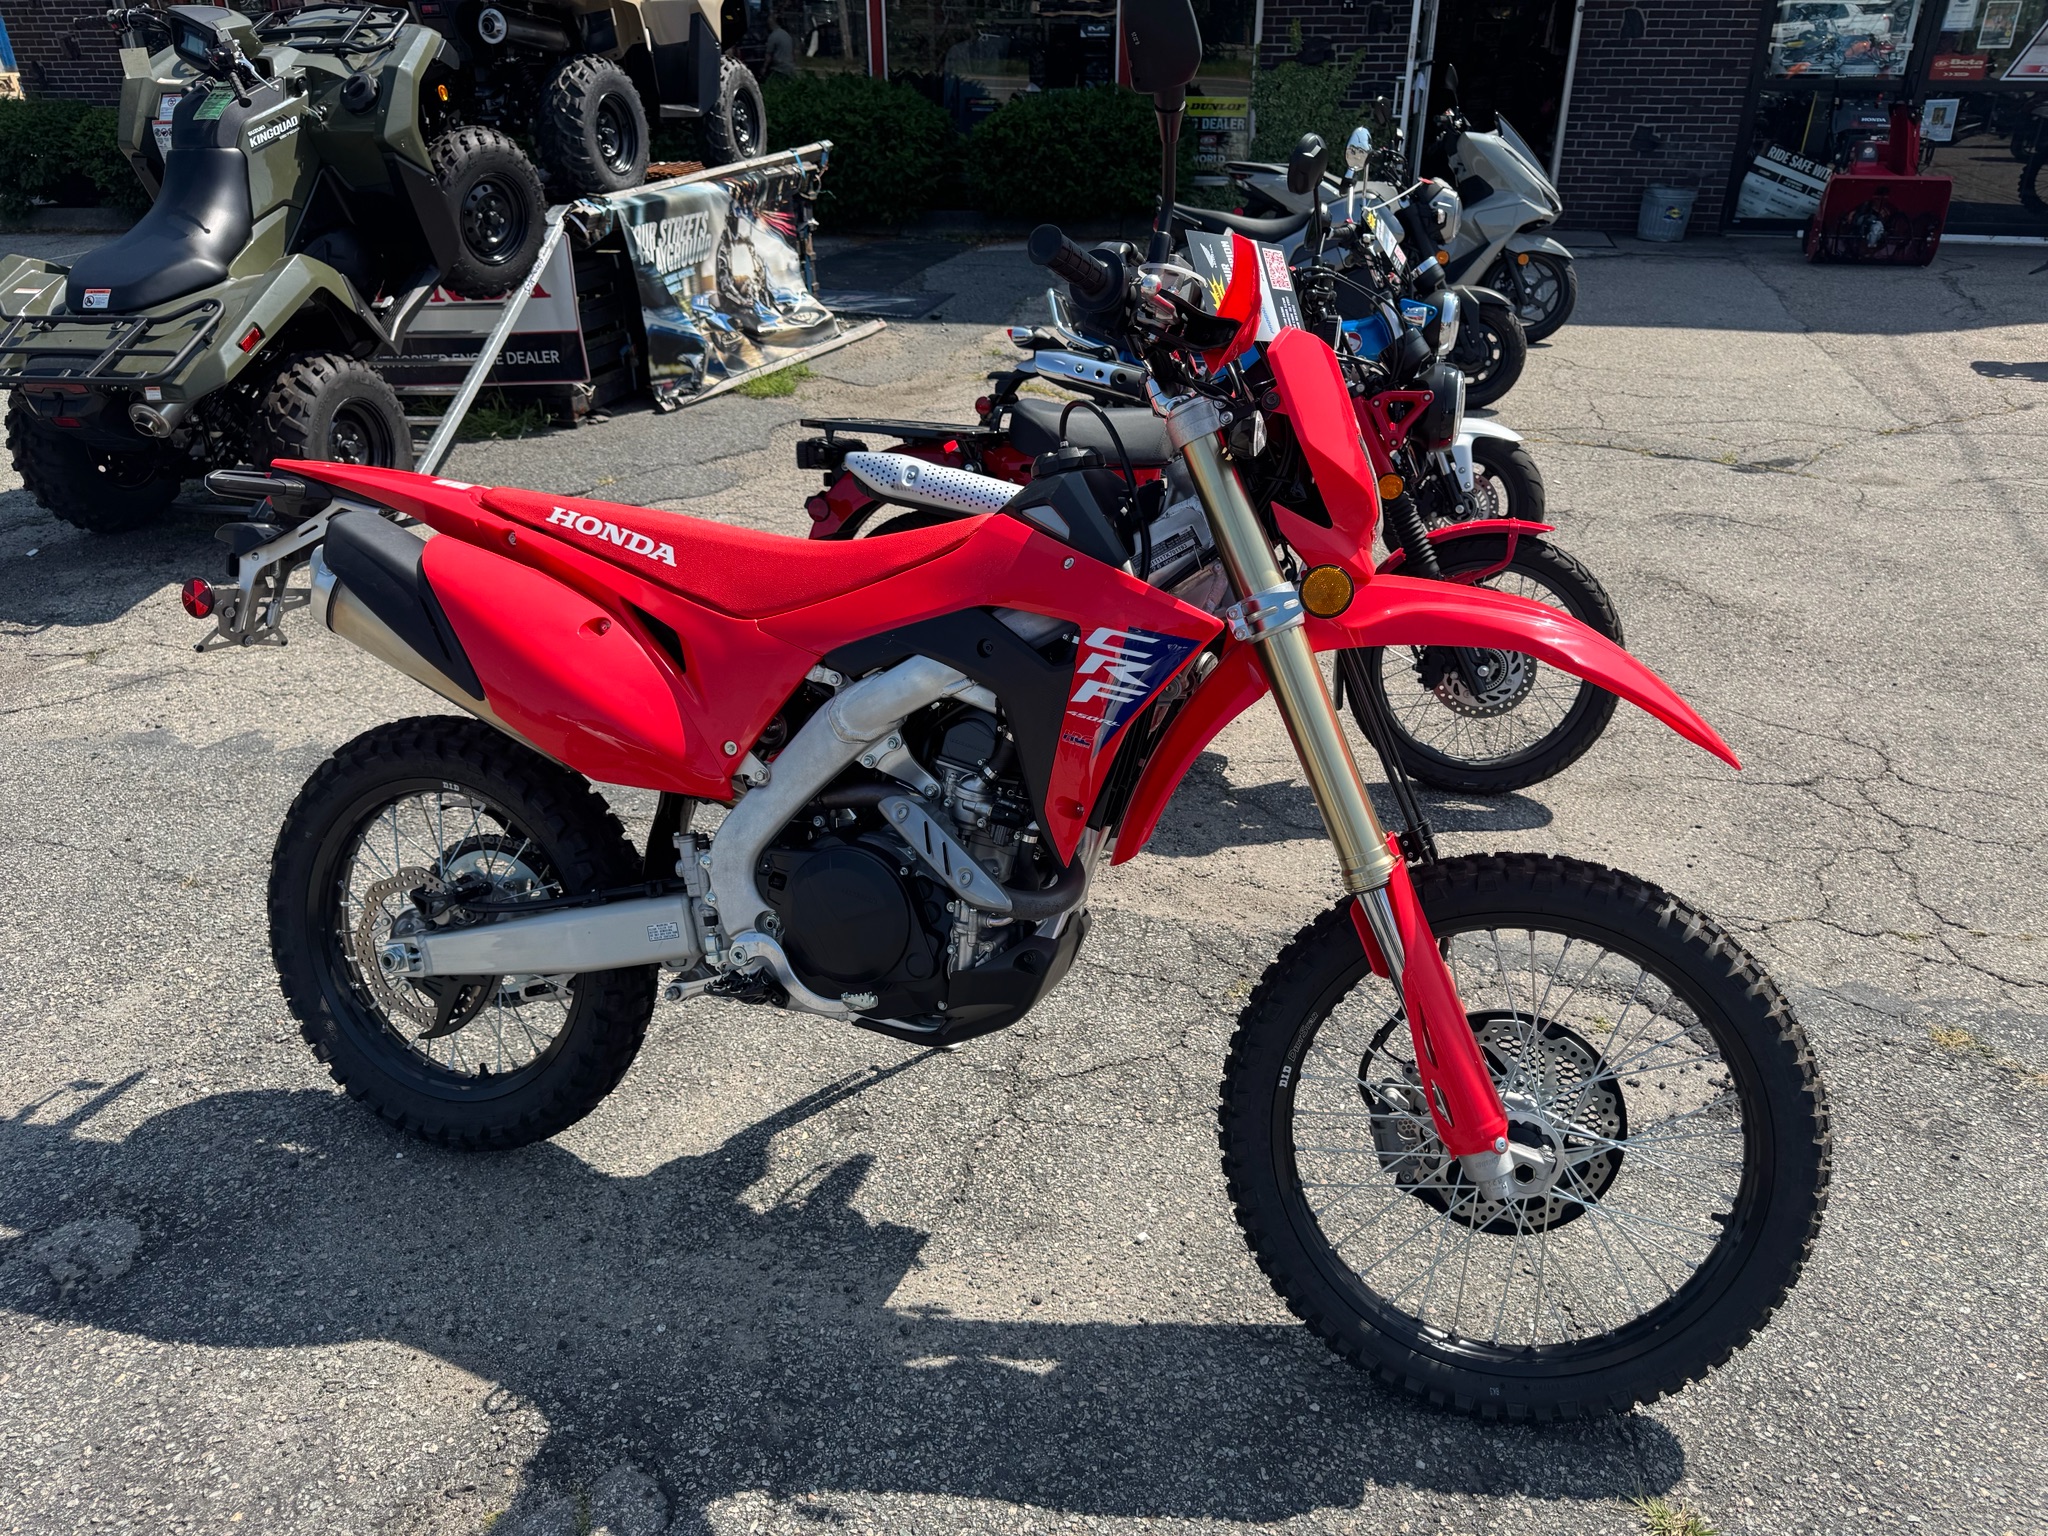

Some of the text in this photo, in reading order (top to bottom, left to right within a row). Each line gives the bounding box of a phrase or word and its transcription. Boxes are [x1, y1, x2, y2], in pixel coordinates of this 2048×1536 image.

[249, 115, 299, 148] KINGQUAD
[1202, 117, 1245, 130] DEALER
[1767, 146, 1832, 181] RIDE SAFE WIT
[632, 221, 657, 251] OUR
[1221, 262, 1233, 285] OUR
[506, 349, 560, 365] DEALER
[545, 506, 677, 568] HONDA
[1070, 627, 1161, 703] CRF
[1066, 711, 1121, 726] 450RL
